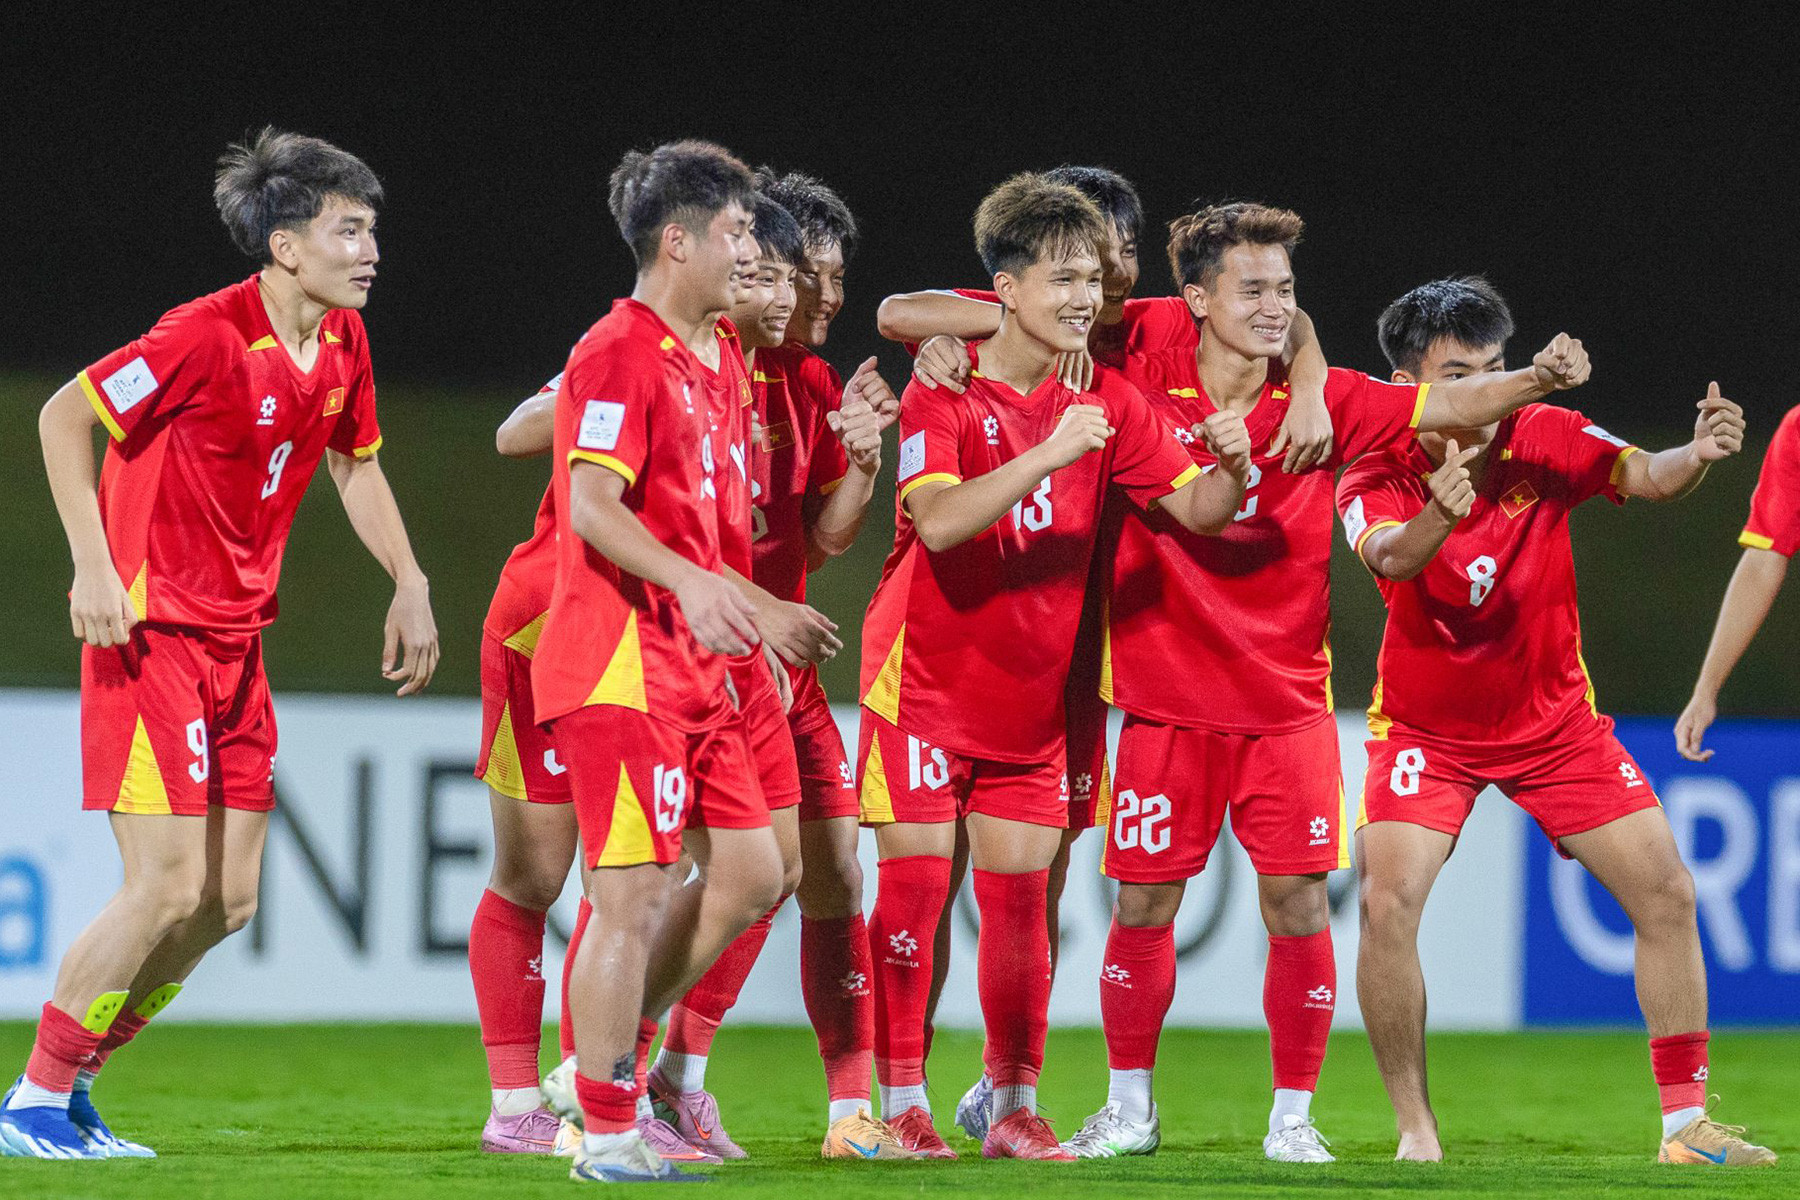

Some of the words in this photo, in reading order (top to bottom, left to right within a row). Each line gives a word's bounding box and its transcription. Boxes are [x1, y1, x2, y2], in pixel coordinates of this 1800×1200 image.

[261, 440, 294, 501] 9
[1465, 554, 1498, 608] 8
[186, 717, 209, 784] 9
[907, 734, 950, 791] 13
[1389, 747, 1426, 797] 8
[653, 763, 687, 834] 19
[1114, 788, 1172, 855] 22
